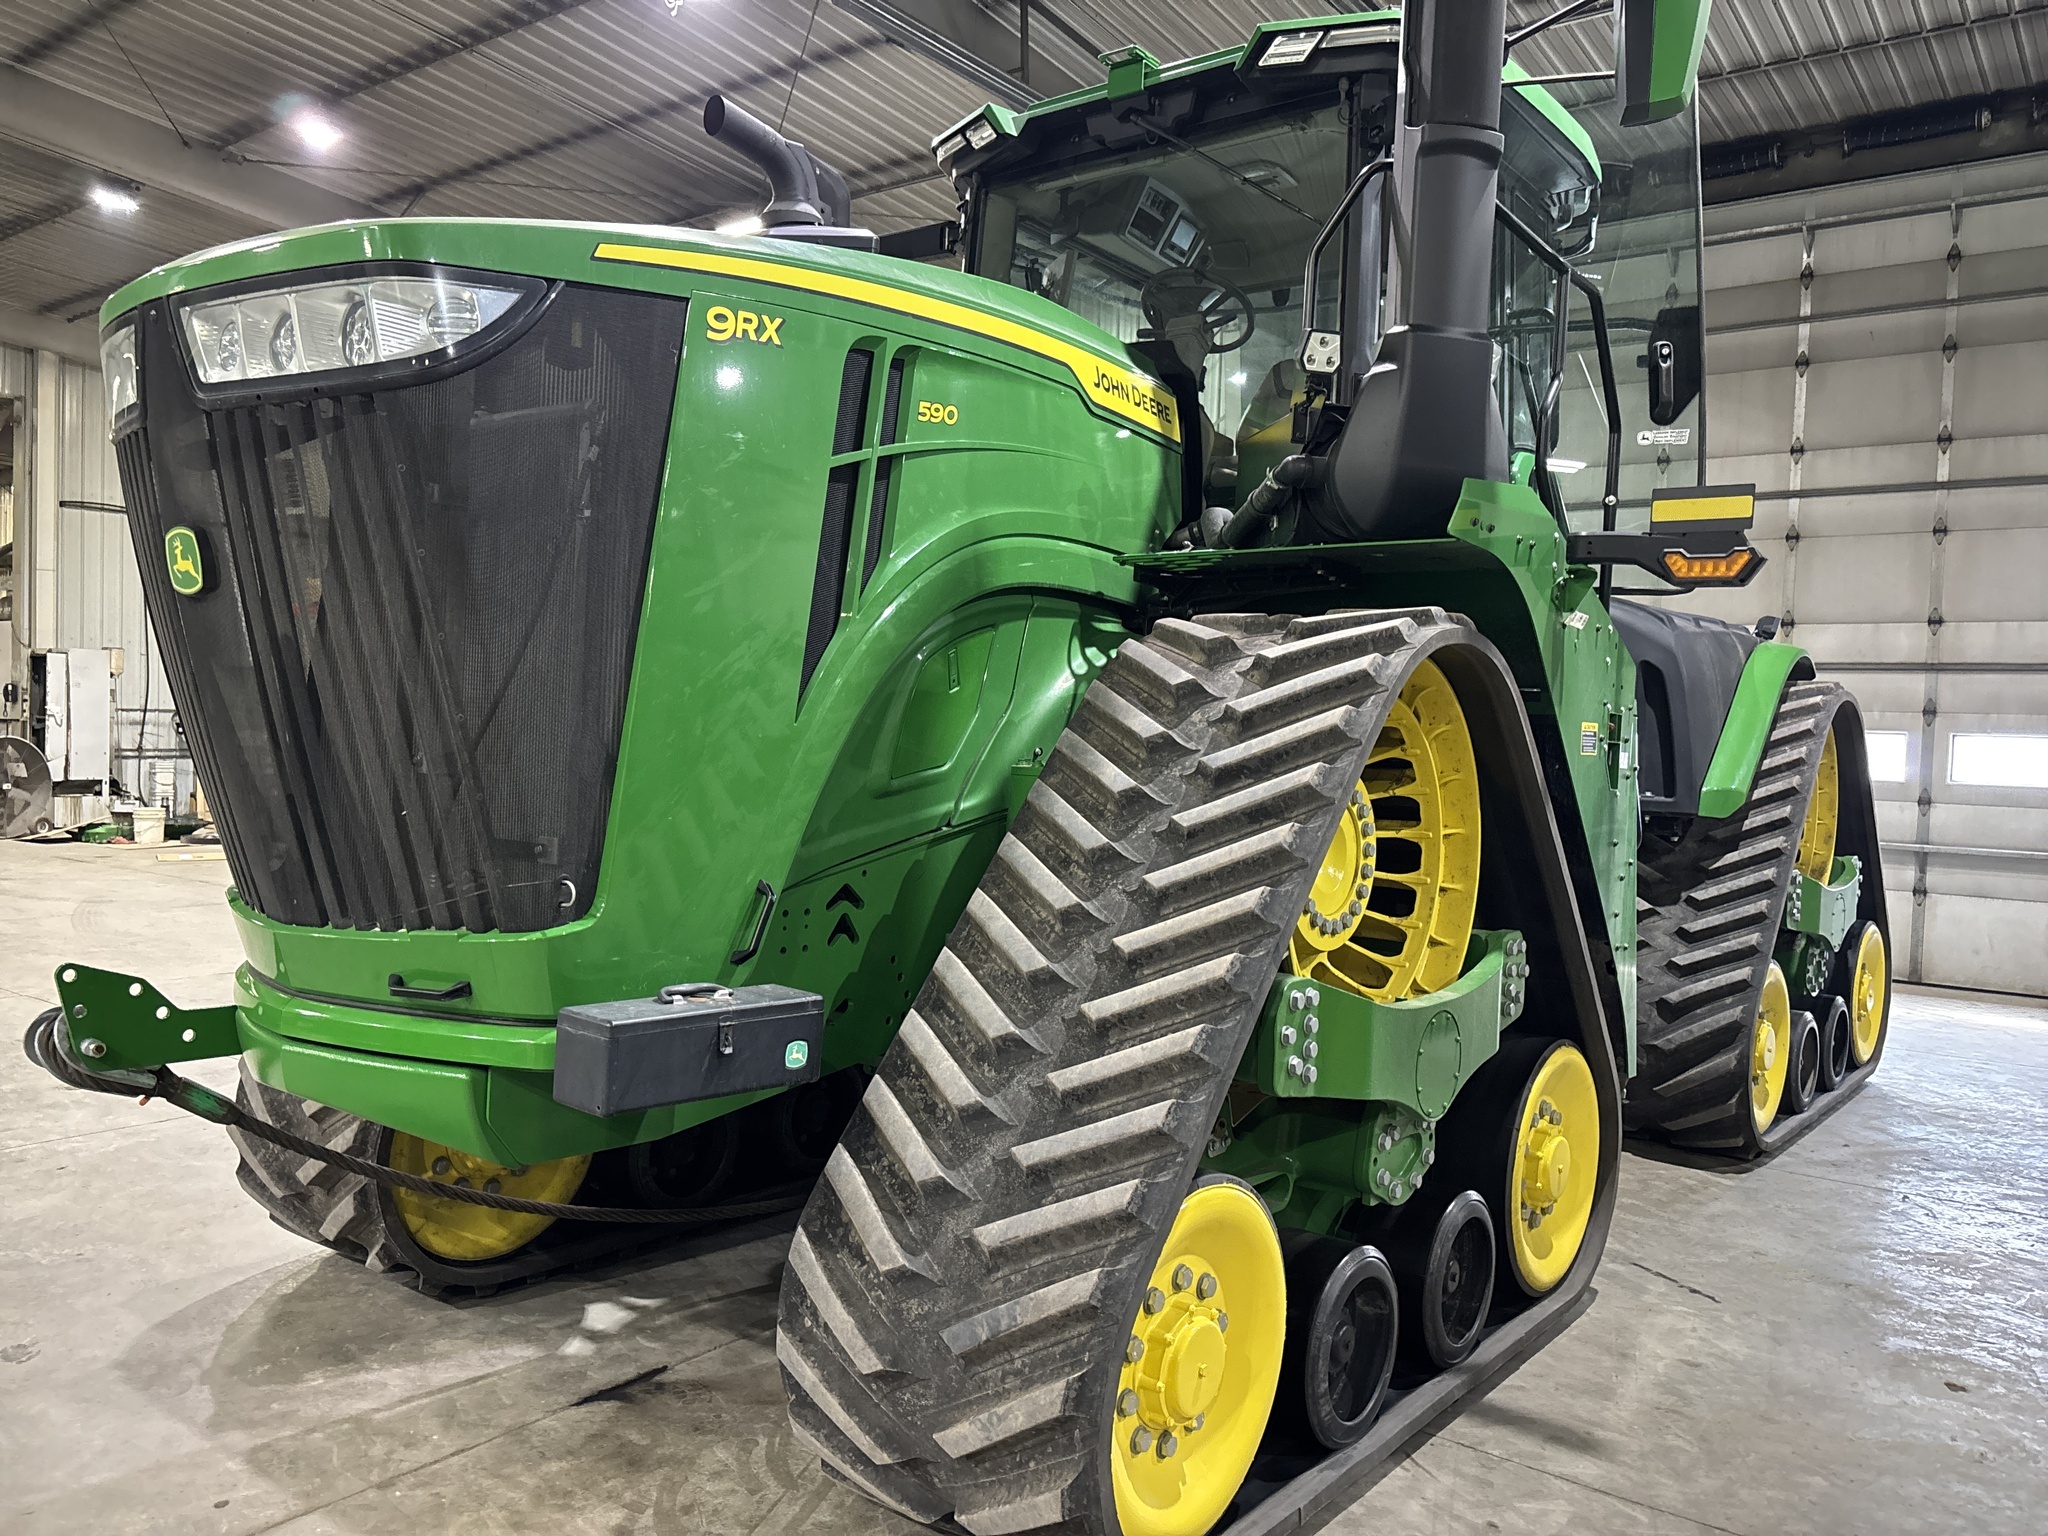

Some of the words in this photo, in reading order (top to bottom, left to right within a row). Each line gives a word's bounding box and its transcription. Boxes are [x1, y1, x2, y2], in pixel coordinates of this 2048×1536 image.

[706, 306, 785, 347] 9RX
[917, 401, 959, 425] 590
[1093, 365, 1130, 403] JOHN
[1131, 384, 1172, 425] DEERE
